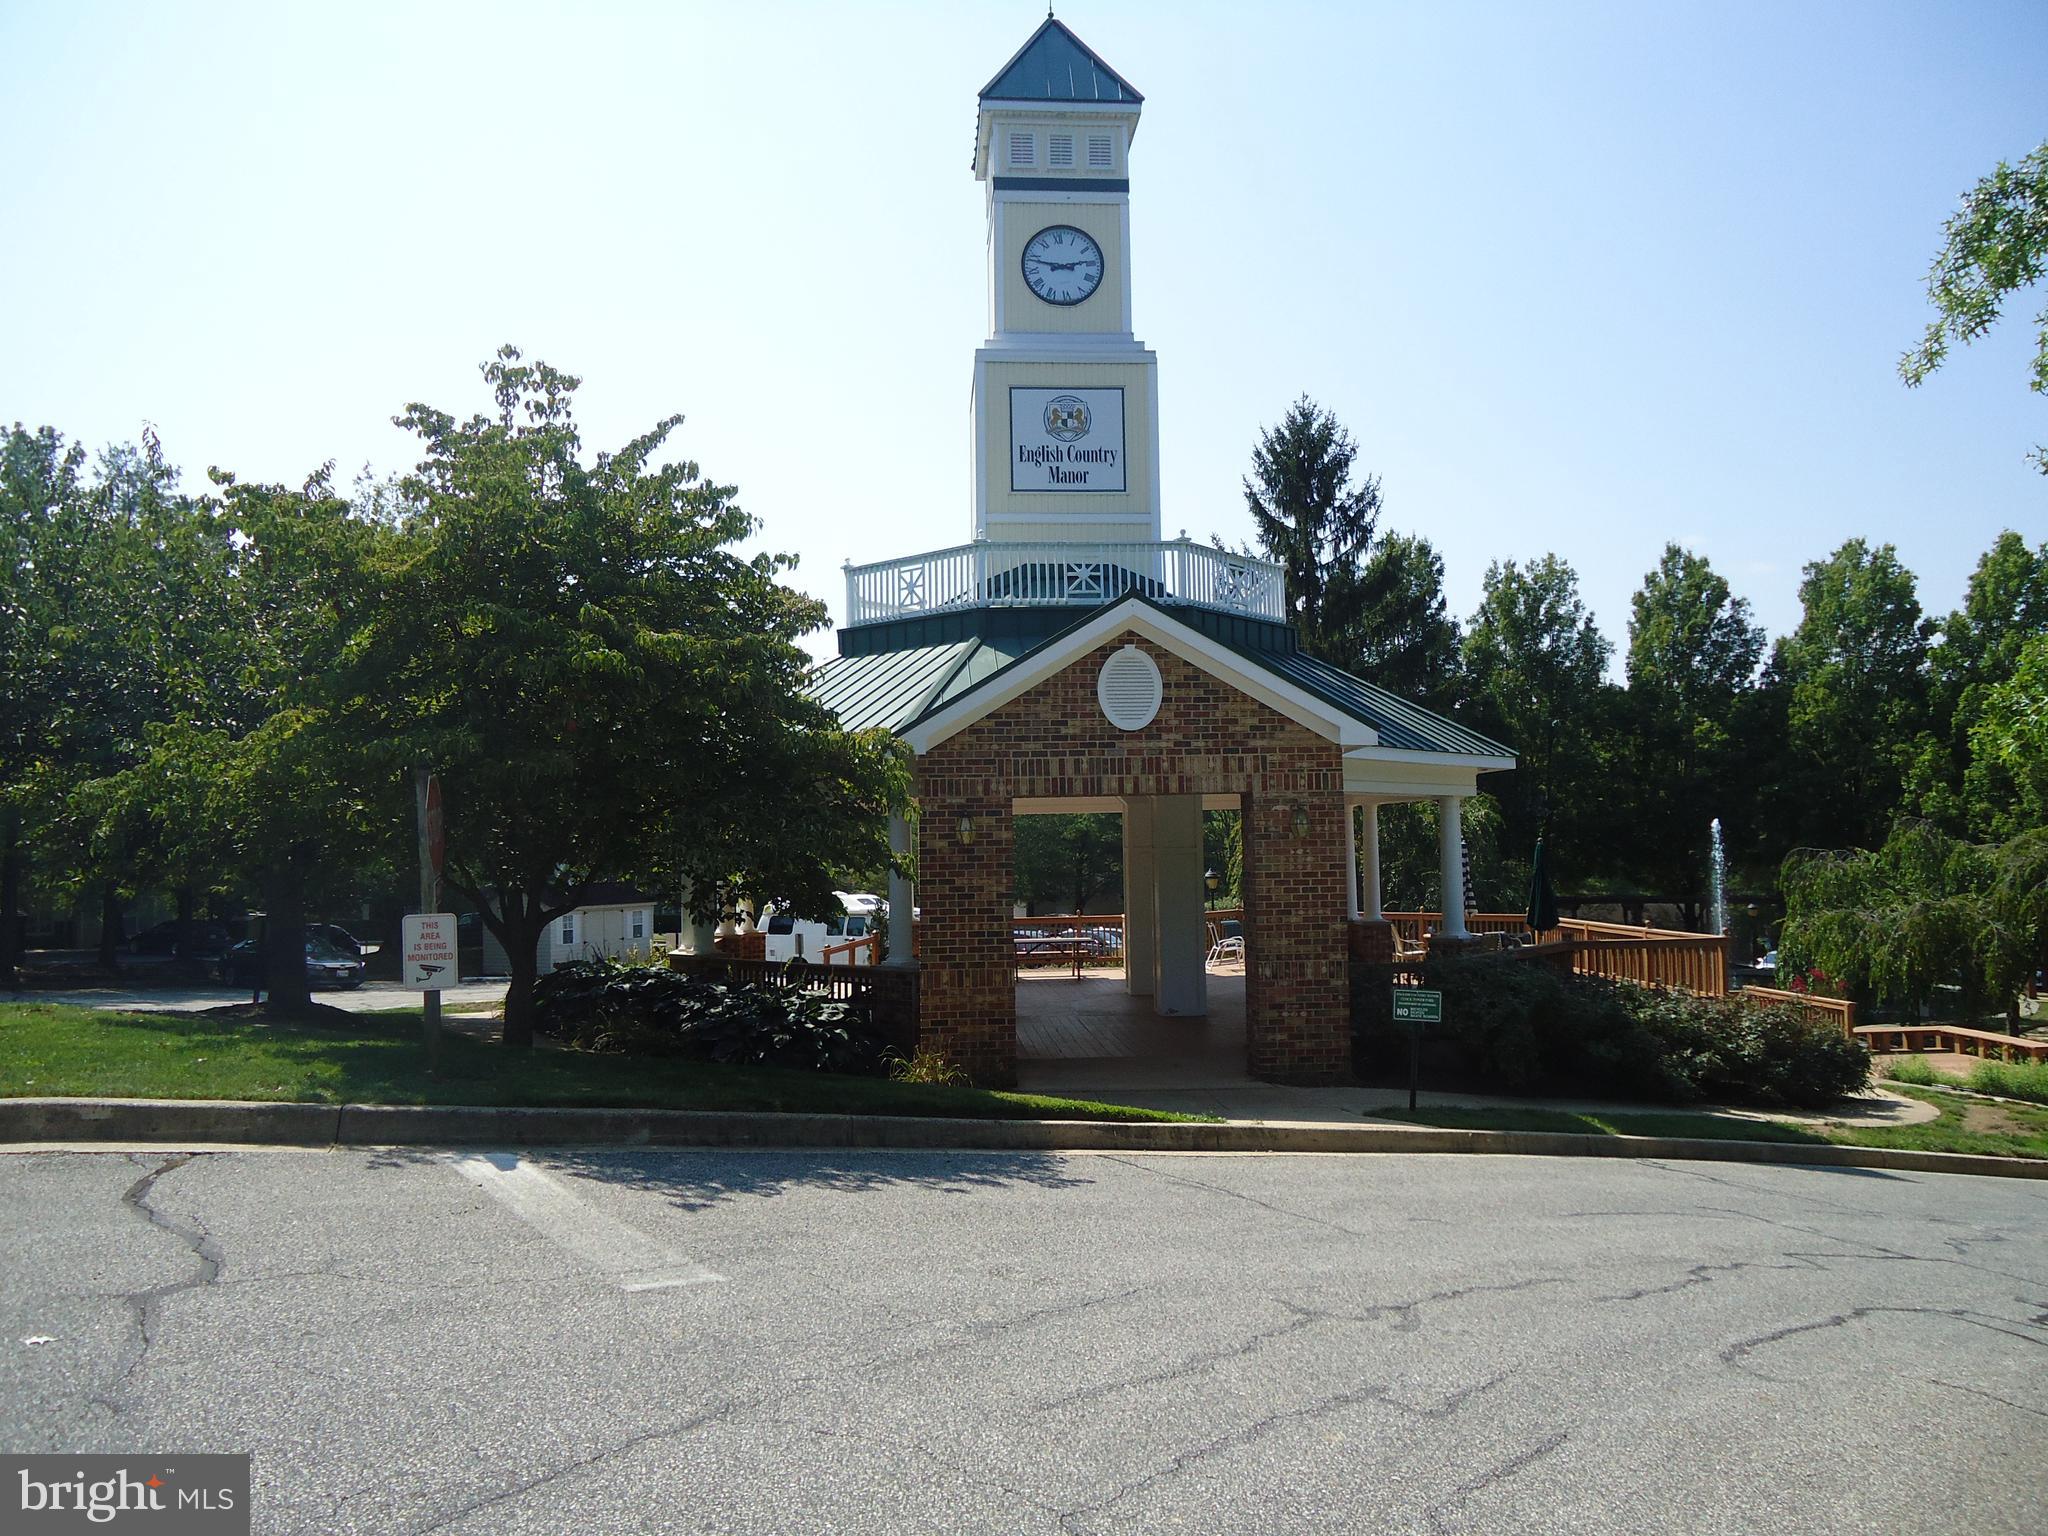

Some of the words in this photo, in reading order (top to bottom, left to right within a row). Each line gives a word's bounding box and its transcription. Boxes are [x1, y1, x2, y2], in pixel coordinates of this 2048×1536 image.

[1019, 445, 1063, 467] English
[1067, 444, 1117, 467] Country
[1048, 465, 1089, 484] Manor
[421, 922, 439, 930] THIS
[420, 932, 440, 940] AREA
[413, 943, 422, 951] IS
[423, 942, 447, 950] BEING
[407, 952, 454, 962] MONITORED
[1396, 1008, 1409, 1016] NO
